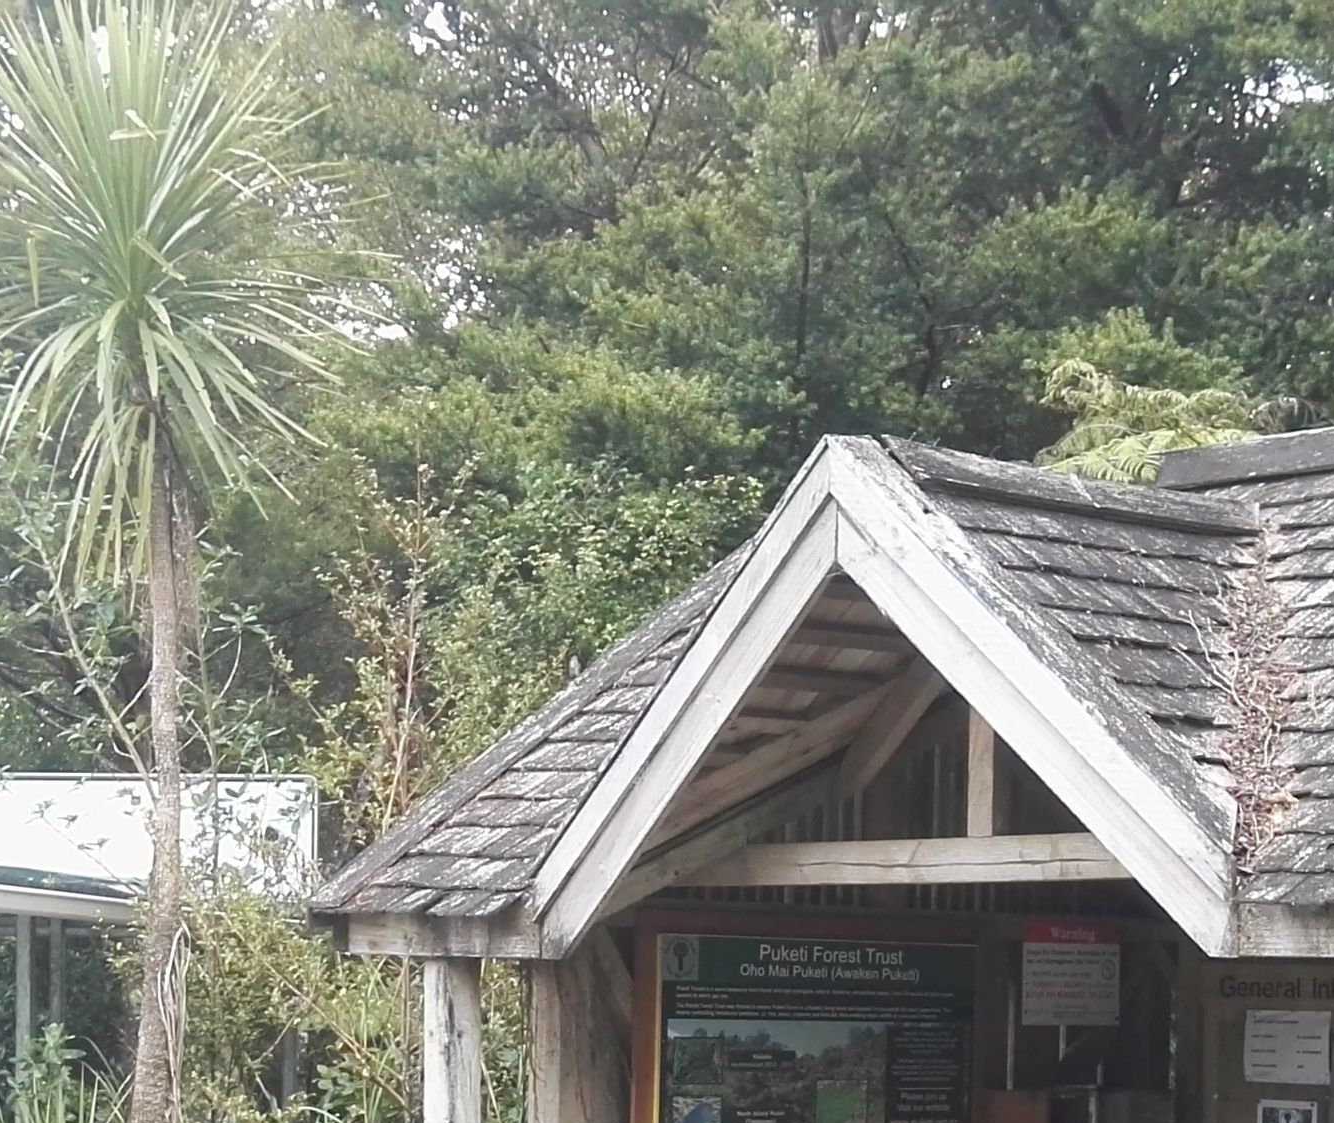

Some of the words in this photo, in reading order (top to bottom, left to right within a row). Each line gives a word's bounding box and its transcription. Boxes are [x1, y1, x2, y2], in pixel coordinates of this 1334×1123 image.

[759, 943, 808, 963] Puketi
[813, 946, 861, 964] Forest
[864, 948, 903, 965] Trust
[739, 963, 766, 977] Oho
[768, 964, 790, 978] Mai
[793, 965, 828, 978] Puketi
[830, 966, 879, 981] (Awaken
[881, 968, 921, 983] Puketi)
[1219, 975, 1302, 999] General
